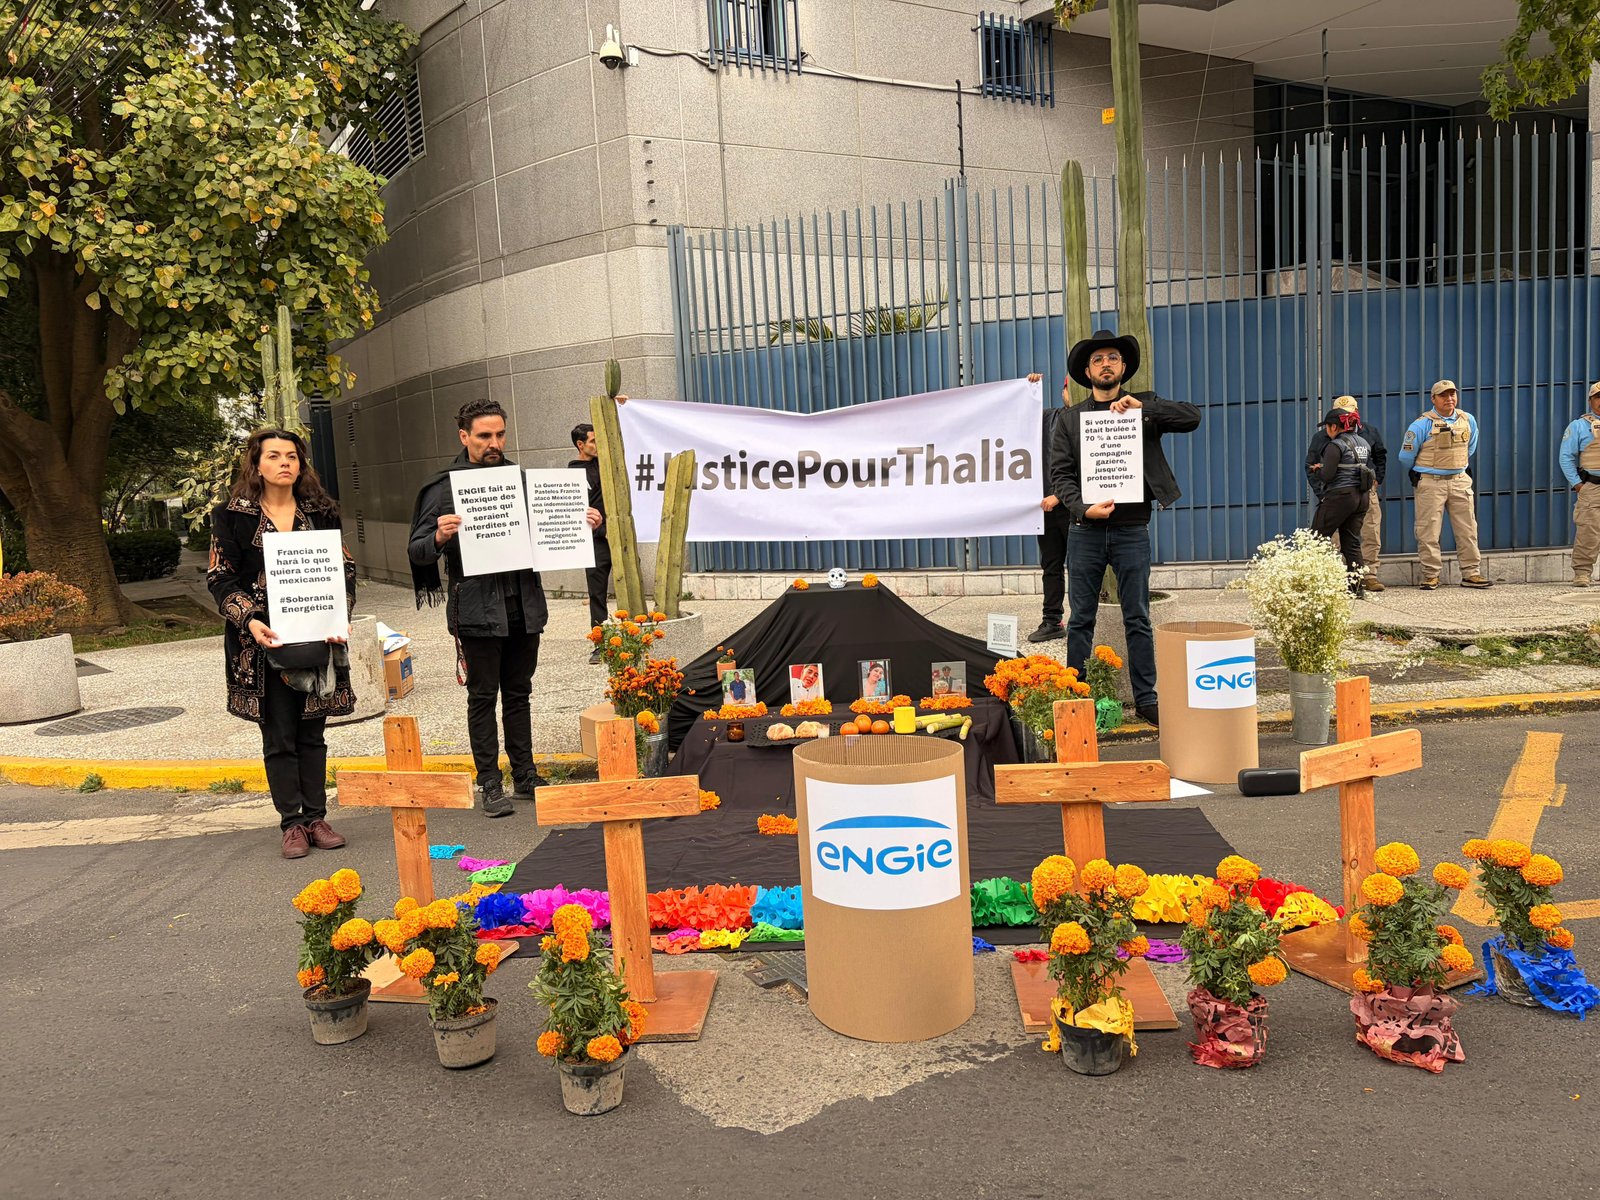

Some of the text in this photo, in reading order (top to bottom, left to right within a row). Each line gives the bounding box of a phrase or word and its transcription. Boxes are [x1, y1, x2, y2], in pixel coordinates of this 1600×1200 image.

[1086, 474, 1136, 482] protesteriez-
[457, 486, 487, 496] ENGIE
[488, 484, 504, 492] fait
[460, 493, 516, 504] Mexique des
[466, 501, 514, 513] choses qui
[473, 511, 510, 522] seraient
[464, 521, 507, 532] interdites
[475, 530, 506, 540] France
[277, 548, 314, 556] Francia
[276, 557, 299, 566] hará
[313, 557, 331, 565] que
[270, 568, 301, 576] quiera
[279, 576, 332, 584] mexicanos
[279, 594, 334, 603] #Soberanía
[281, 604, 334, 613] Energética
